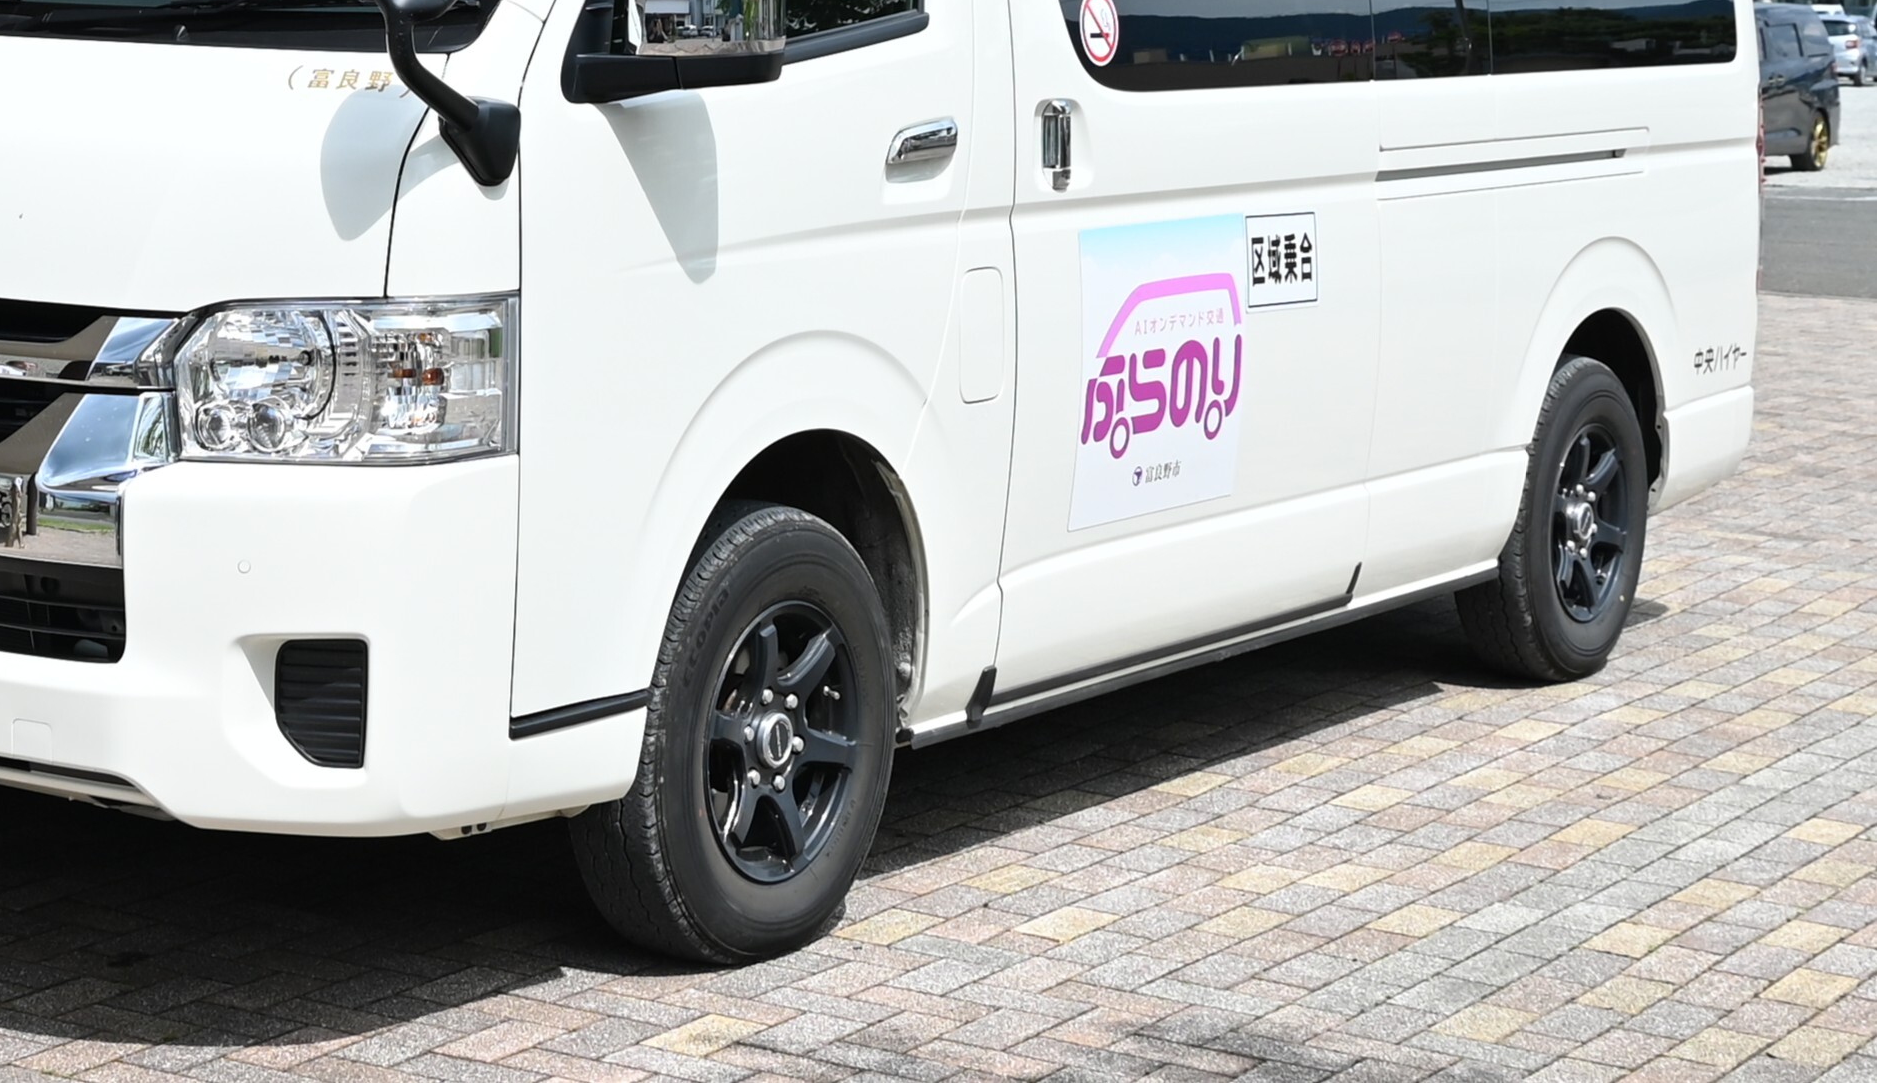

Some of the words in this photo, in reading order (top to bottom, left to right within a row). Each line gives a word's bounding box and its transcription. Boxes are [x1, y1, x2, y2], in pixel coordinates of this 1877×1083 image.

[1251, 231, 1313, 287] 区域乗合
[1134, 308, 1225, 335] AIオンデマンド交通
[1693, 342, 1747, 375] 中央ハイヤー
[1144, 460, 1182, 484] 富良野市
